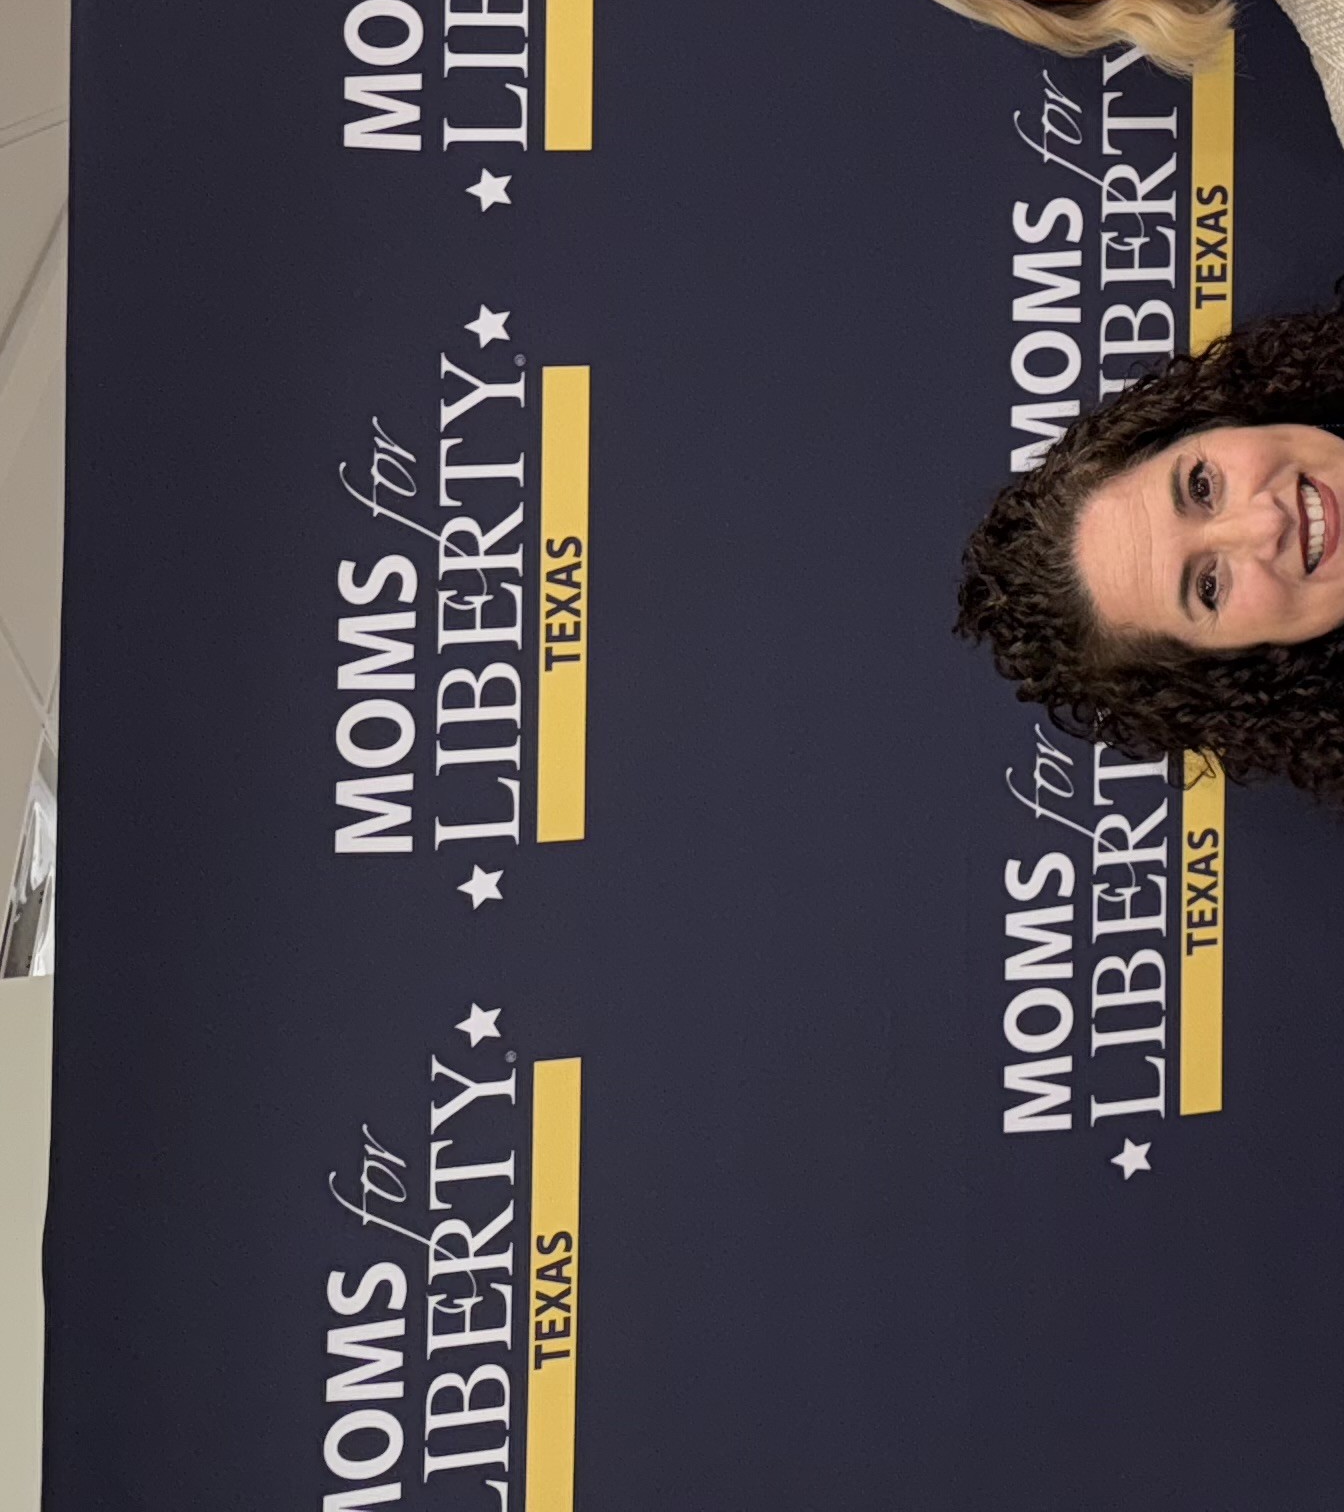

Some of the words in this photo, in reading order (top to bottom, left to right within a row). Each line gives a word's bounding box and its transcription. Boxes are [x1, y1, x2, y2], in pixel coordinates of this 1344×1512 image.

[1010, 197, 1084, 472] MOMS
[1194, 183, 1229, 309] TEXAS
[334, 554, 418, 854] MOMS
[433, 352, 529, 851] LIBERTY
[544, 535, 583, 672] TEXAS
[1003, 851, 1075, 1134] MOMS
[1089, 742, 1169, 1127] LIBERT
[1184, 827, 1220, 955] TEXAS
[534, 1230, 573, 1370] TEXAS
